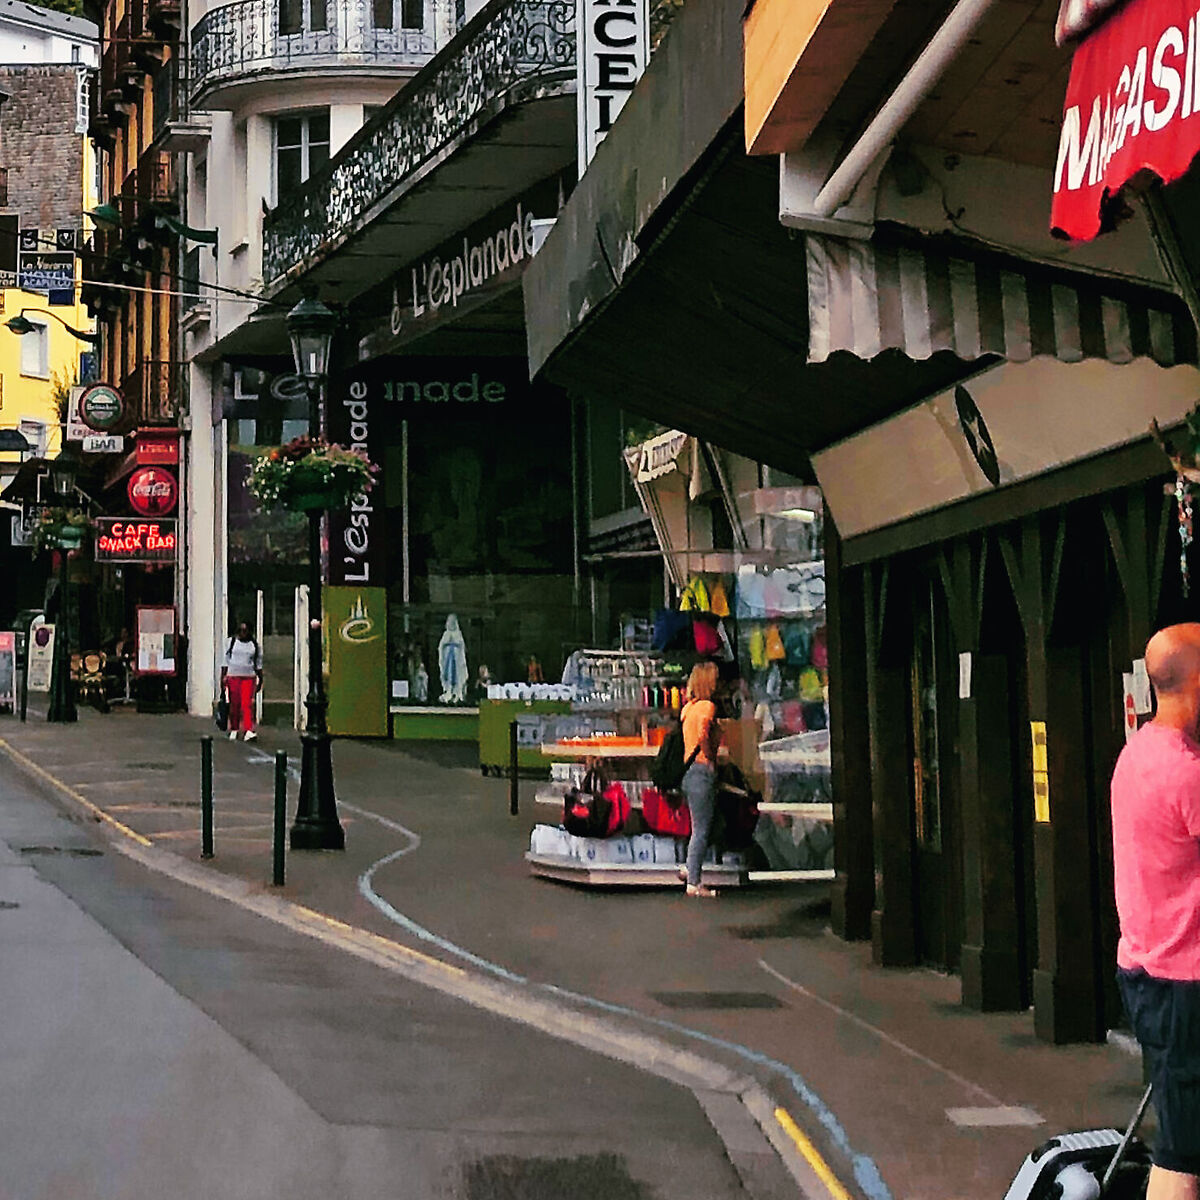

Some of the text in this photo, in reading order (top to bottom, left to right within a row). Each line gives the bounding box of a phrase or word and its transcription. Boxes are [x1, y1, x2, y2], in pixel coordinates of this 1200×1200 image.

[1053, 6, 1200, 194] MAGASI
[90, 439, 116, 450] BAR
[111, 522, 160, 538] CAFE
[99, 532, 175, 553] SNACK BAR
